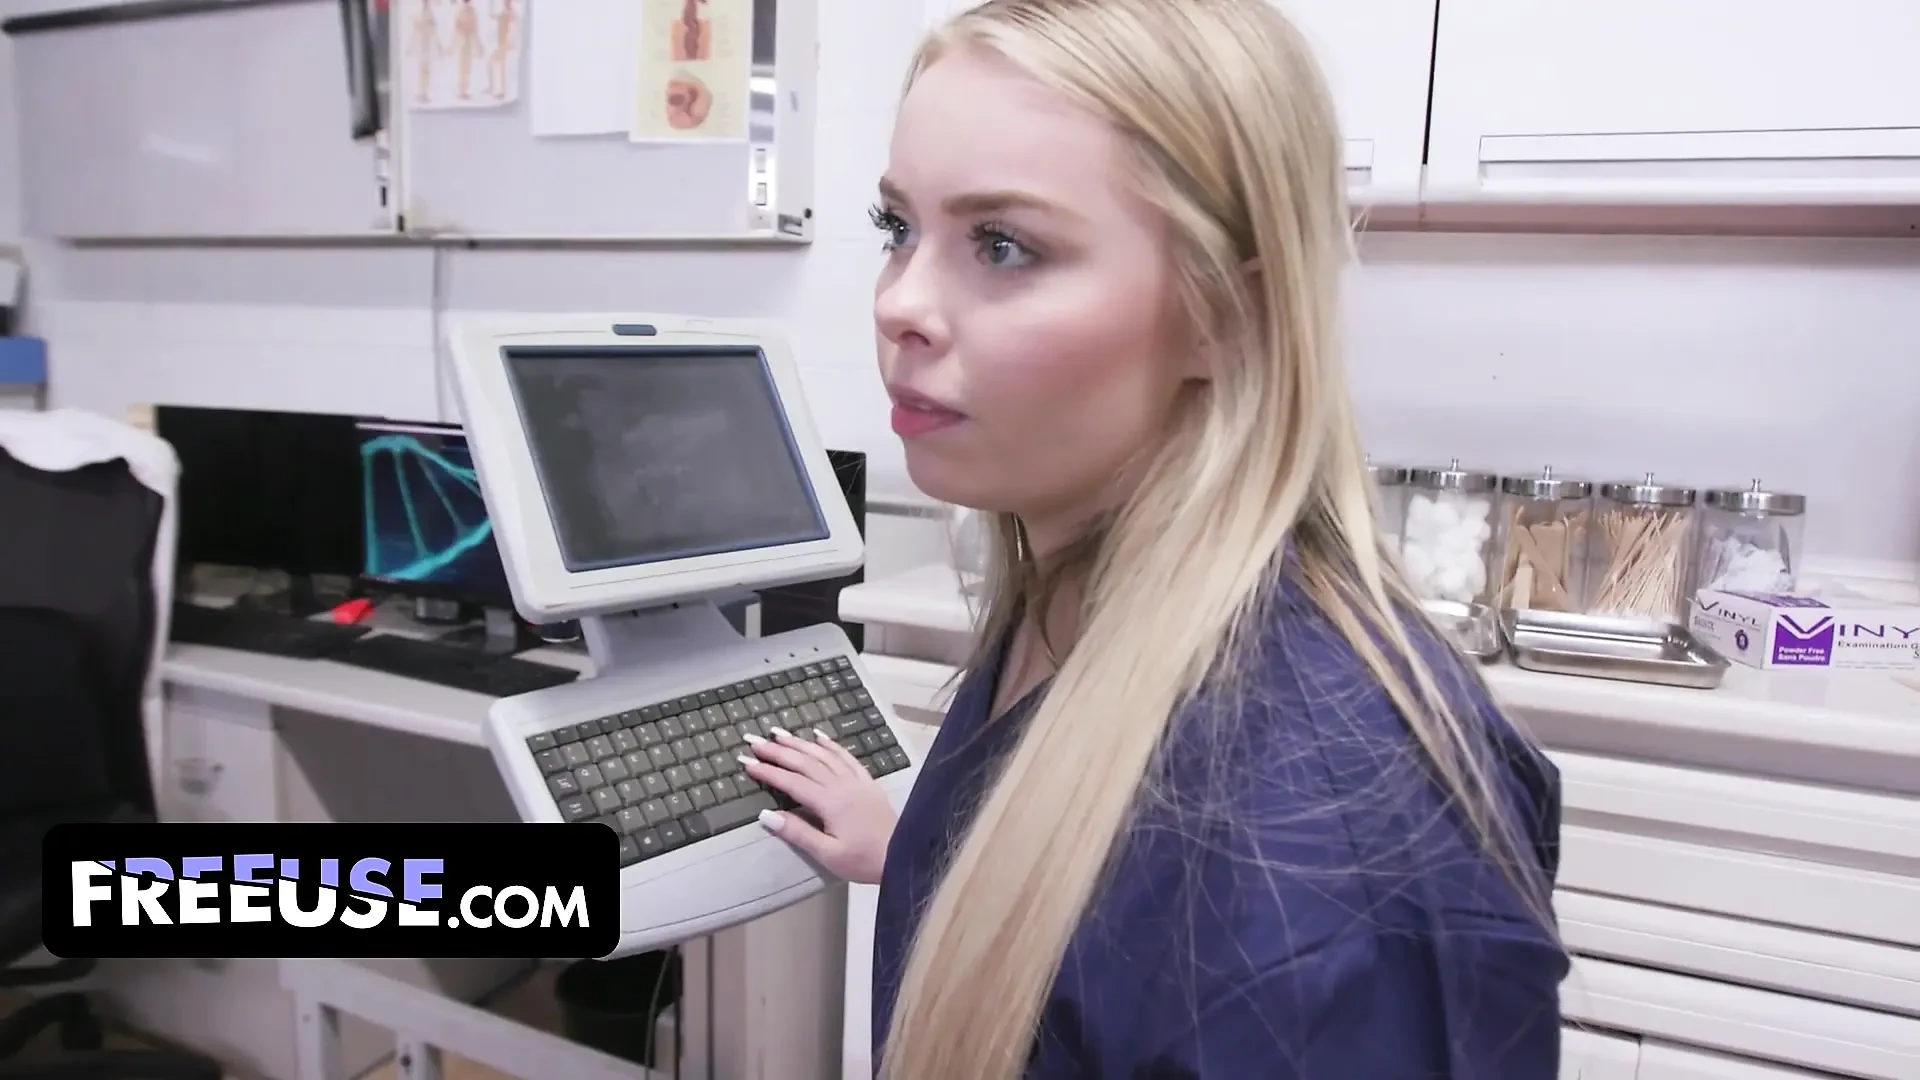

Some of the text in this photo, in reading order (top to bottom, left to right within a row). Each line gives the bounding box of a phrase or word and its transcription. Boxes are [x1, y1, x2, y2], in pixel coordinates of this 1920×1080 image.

[1699, 601, 1759, 626] VINYL
[1838, 640, 1908, 650] Examination
[1779, 647, 1825, 656] Powder Free
